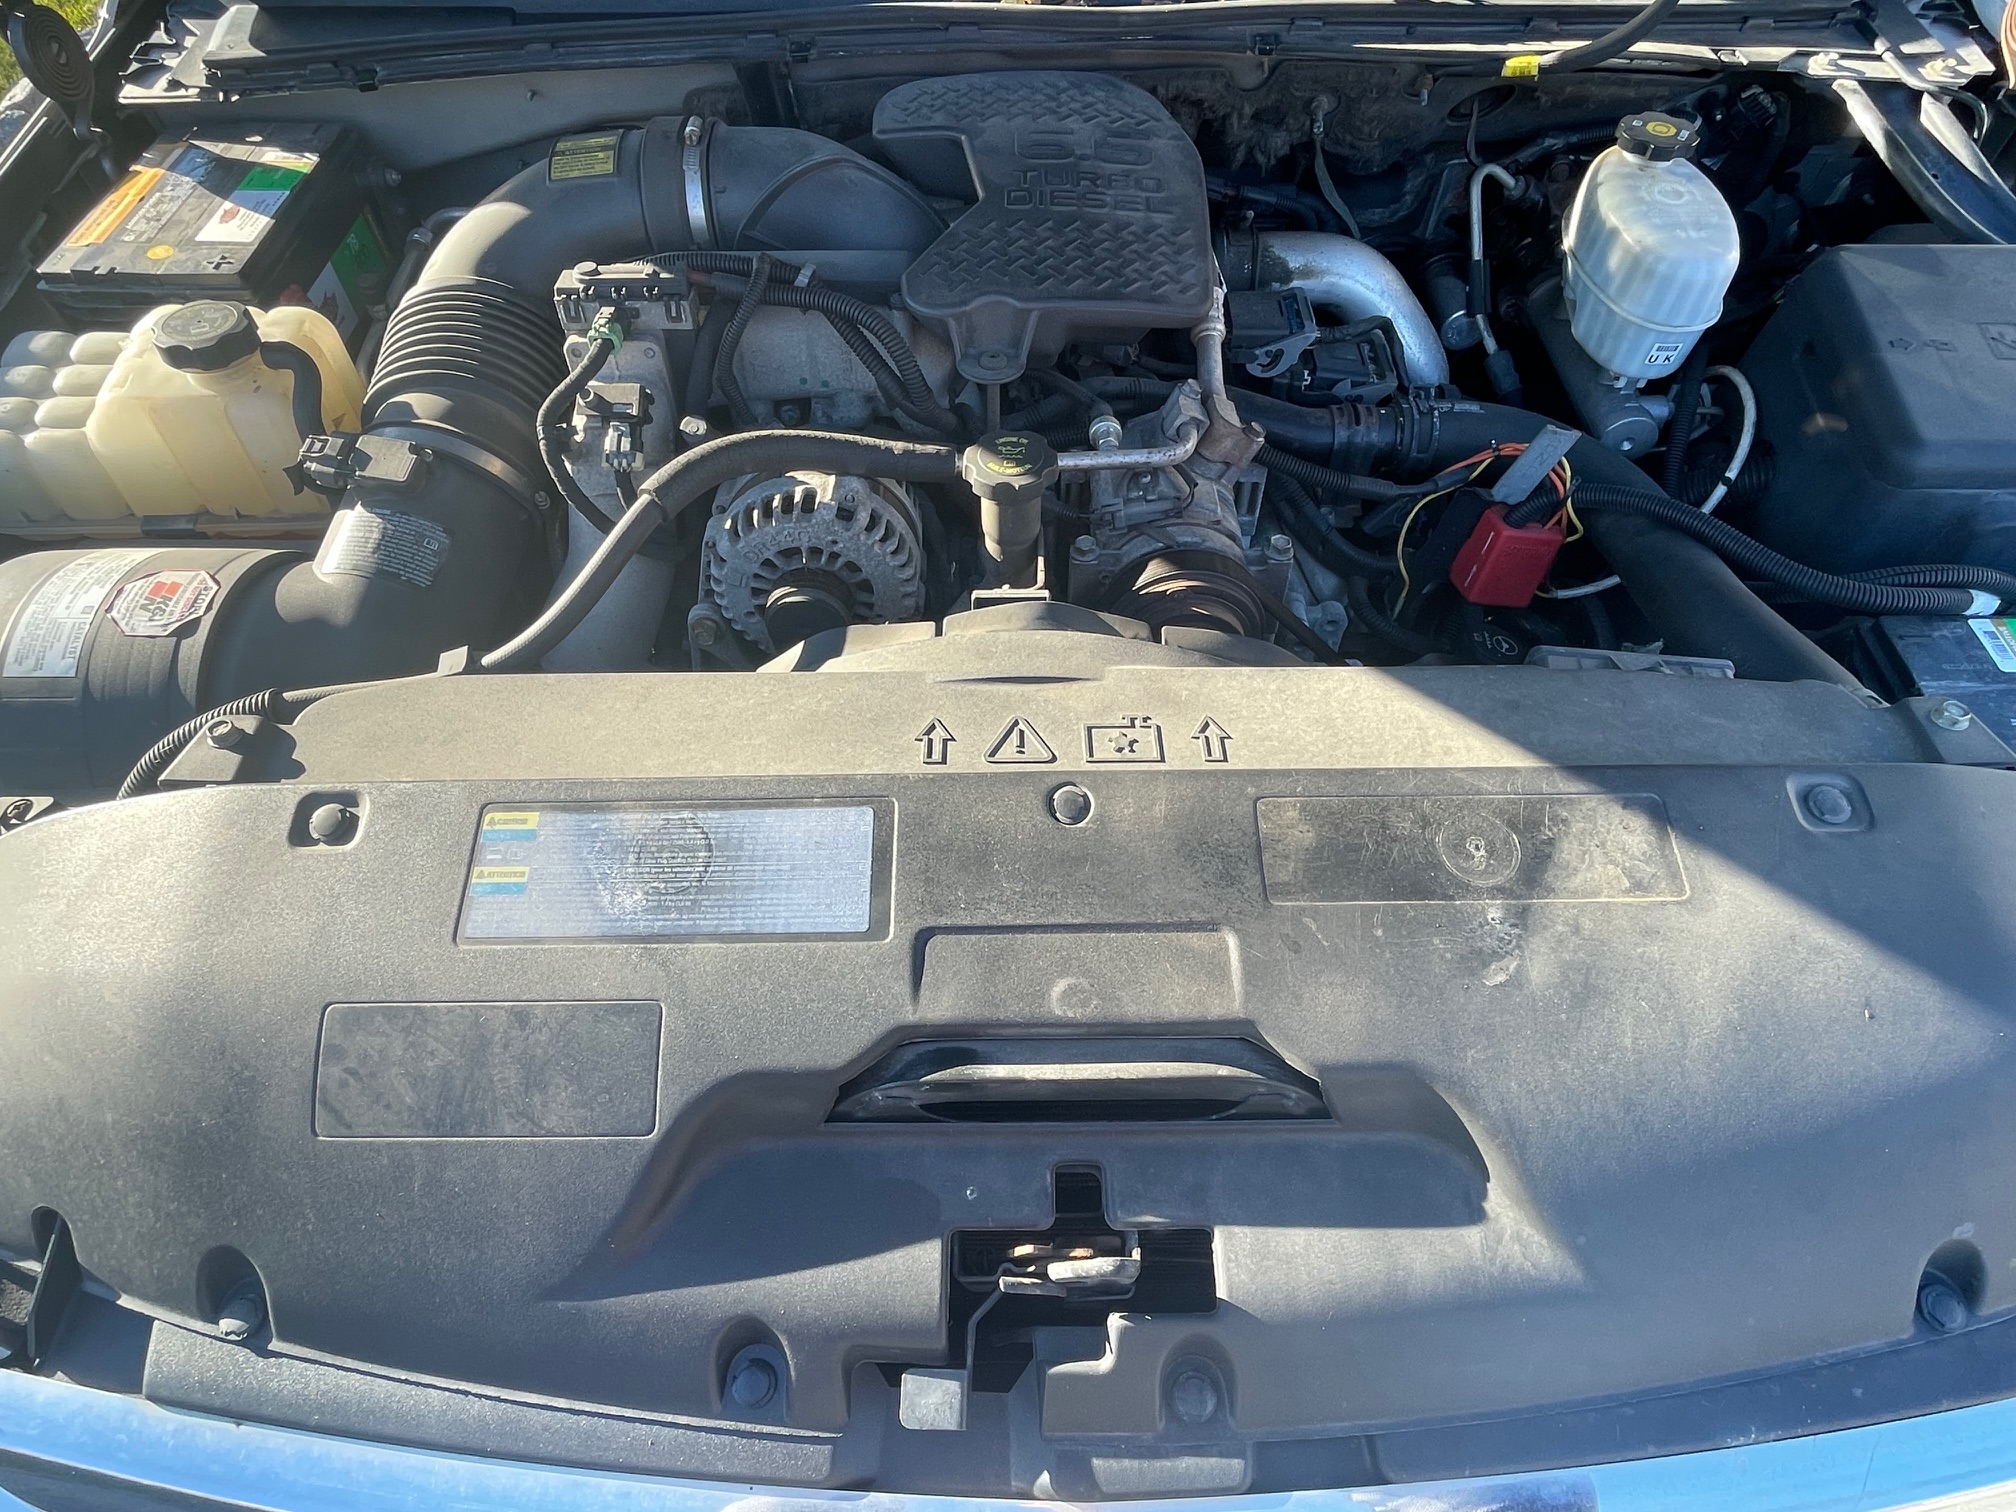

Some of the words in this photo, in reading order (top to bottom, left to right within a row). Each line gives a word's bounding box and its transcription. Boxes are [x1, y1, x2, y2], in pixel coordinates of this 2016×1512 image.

[1012, 168, 1167, 197] TURBO
[1004, 188, 1177, 219] DIESEL
[69, 621, 87, 660] CATALYST
